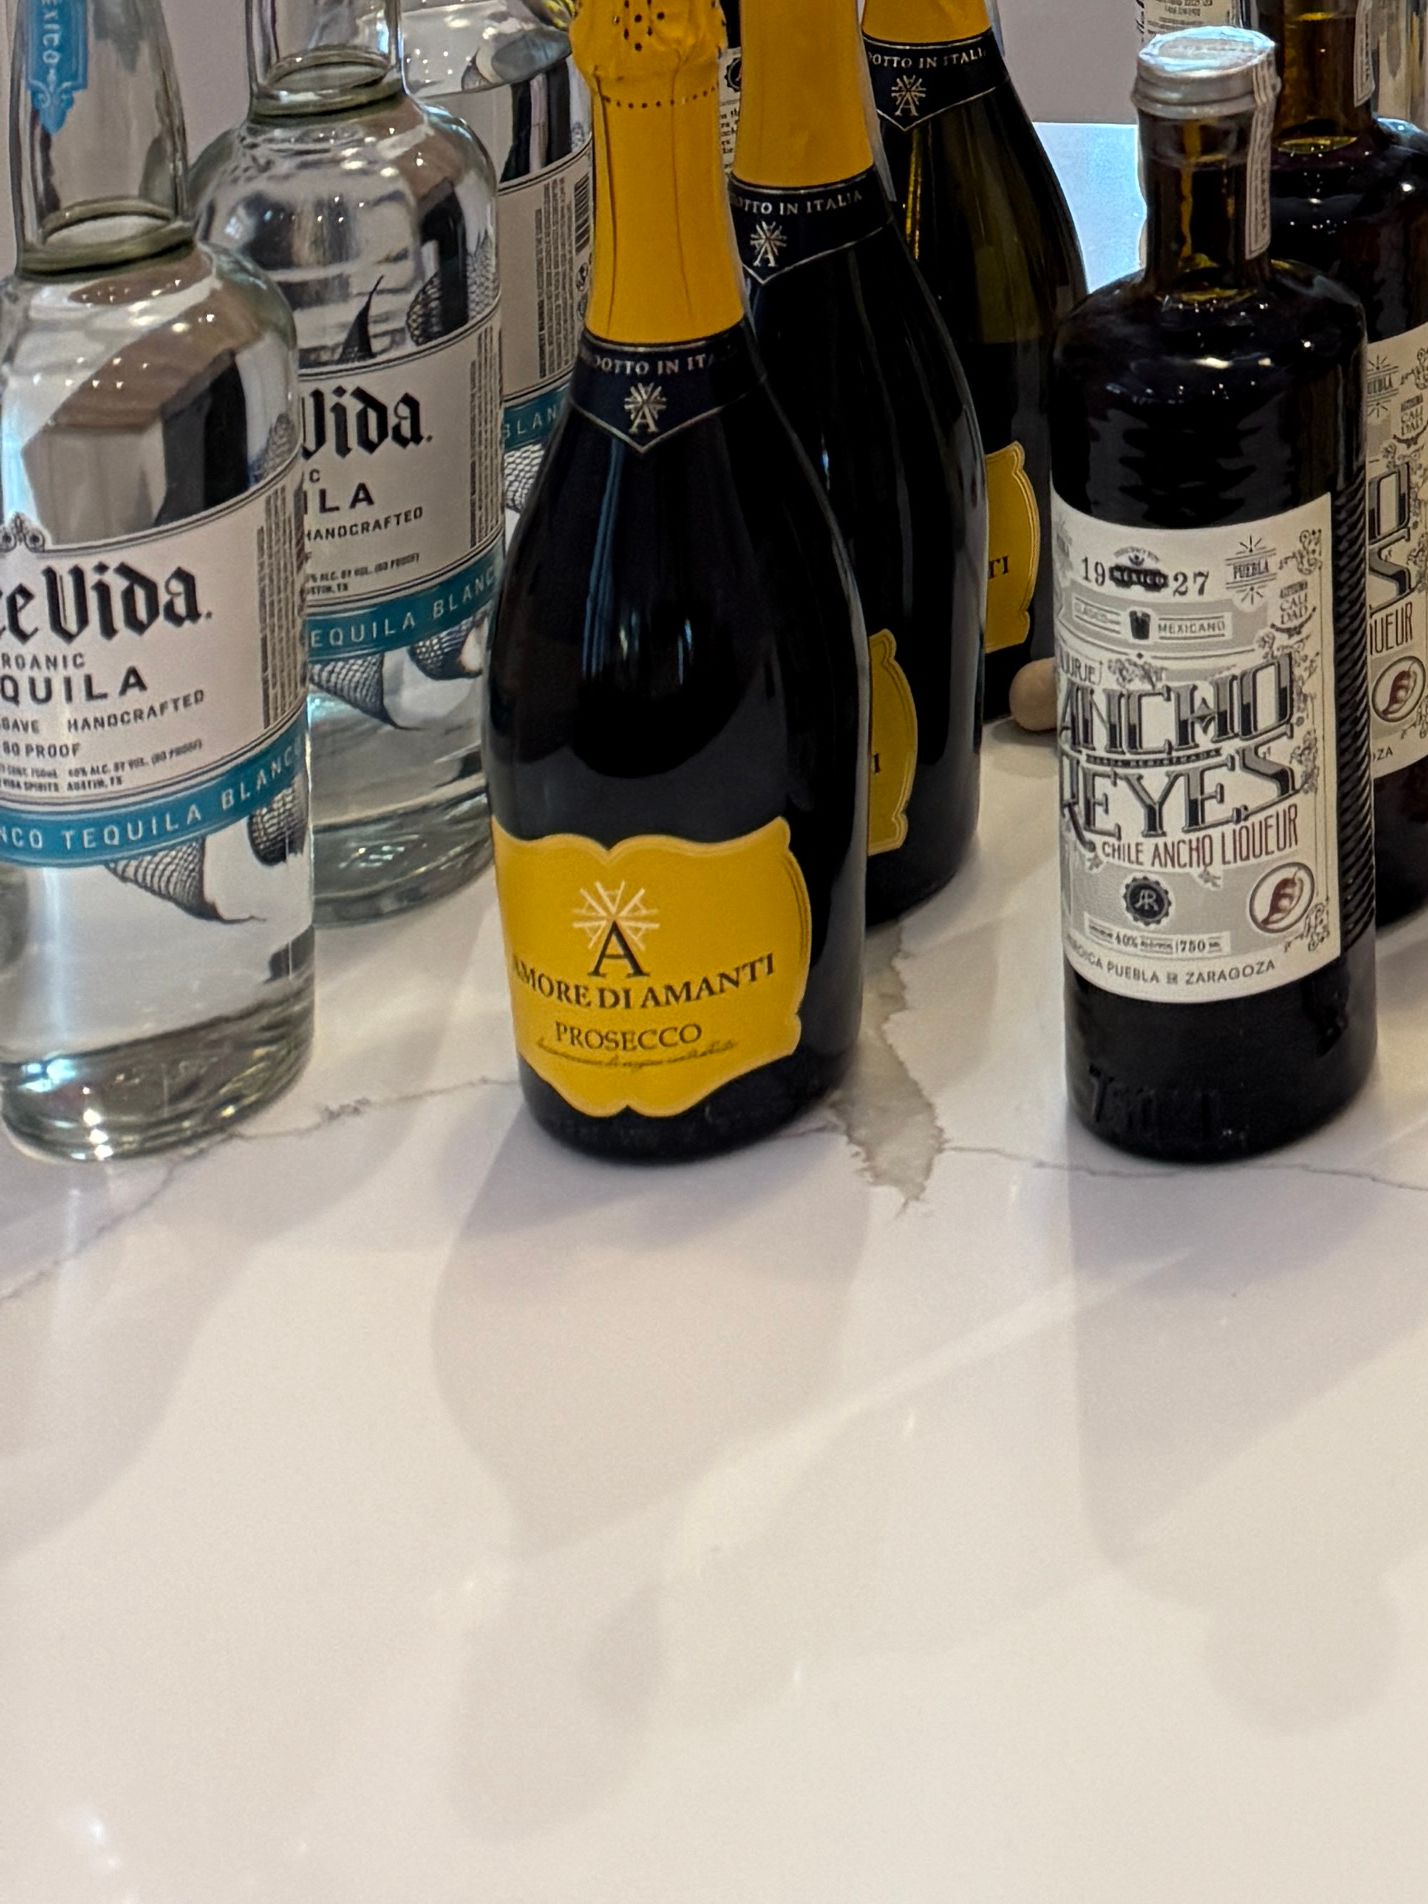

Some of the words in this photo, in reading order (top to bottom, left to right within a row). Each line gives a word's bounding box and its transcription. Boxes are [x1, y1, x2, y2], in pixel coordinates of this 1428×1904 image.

[919, 58, 937, 68] IN
[779, 202, 798, 215] IN
[807, 190, 862, 213] ITALIA
[657, 359, 678, 375] IN
[1082, 557, 1106, 586] 19
[1173, 571, 1209, 596] 27
[1233, 558, 1269, 580] PUEBLA
[1158, 621, 1225, 635] MEXICANO
[67, 689, 204, 733] HANDCRAFTED
[1058, 652, 1294, 754] ANCHO
[26, 743, 81, 759] PROOF
[62, 804, 201, 850] TEQUILA
[1101, 842, 1144, 867] CHILE
[1151, 834, 1214, 869] ANCHO
[1221, 803, 1299, 864] LIQUEUR
[514, 954, 591, 1009] AMORE
[597, 987, 632, 1009] DI
[640, 952, 774, 1009] AMANTI
[1107, 960, 1160, 983] PUEBLA
[1186, 959, 1275, 985] ZARAGOZA
[555, 1021, 702, 1052] PROSECCO
